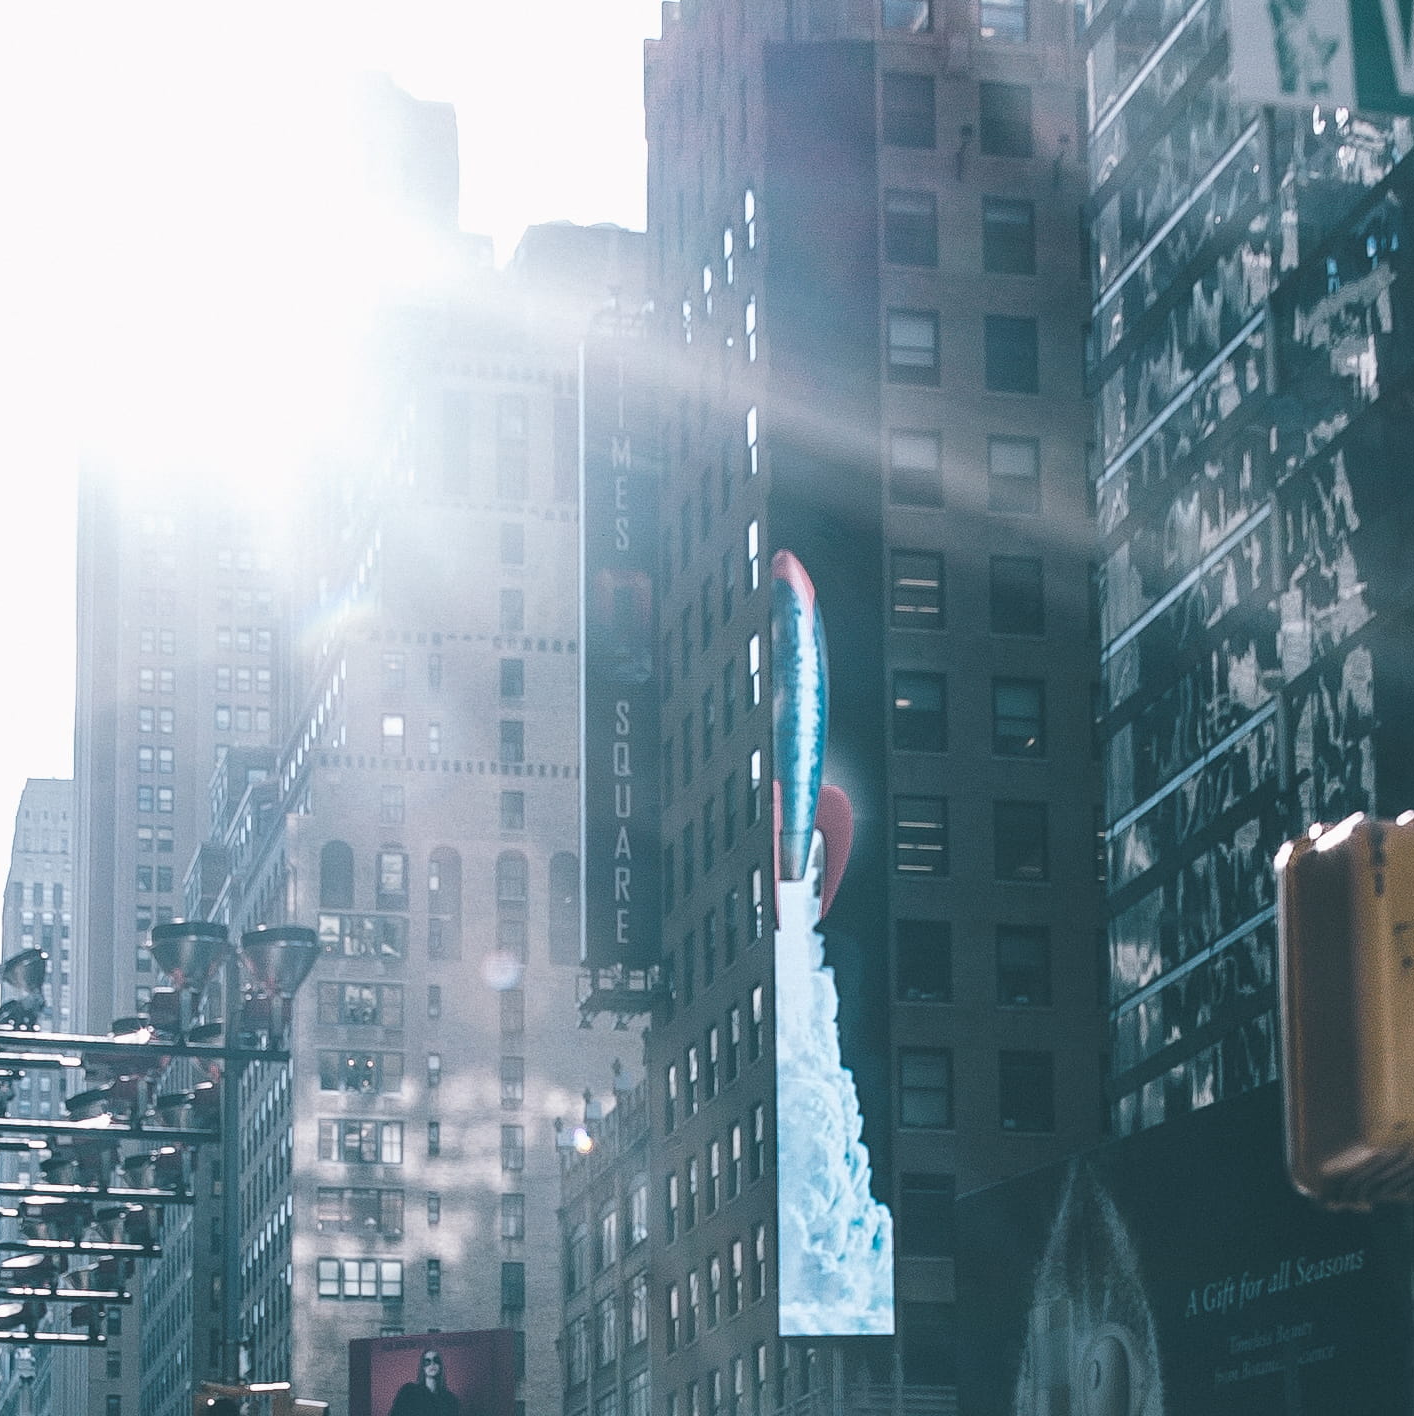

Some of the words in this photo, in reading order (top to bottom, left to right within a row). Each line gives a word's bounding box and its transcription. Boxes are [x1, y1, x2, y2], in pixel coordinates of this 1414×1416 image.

[613, 699, 633, 945] SQUARE
[1184, 1288, 1198, 1318] A
[1202, 1275, 1236, 1315] Gift
[1238, 1270, 1266, 1311] for
[1267, 1259, 1291, 1295] all
[1294, 1248, 1366, 1287] Seasons
